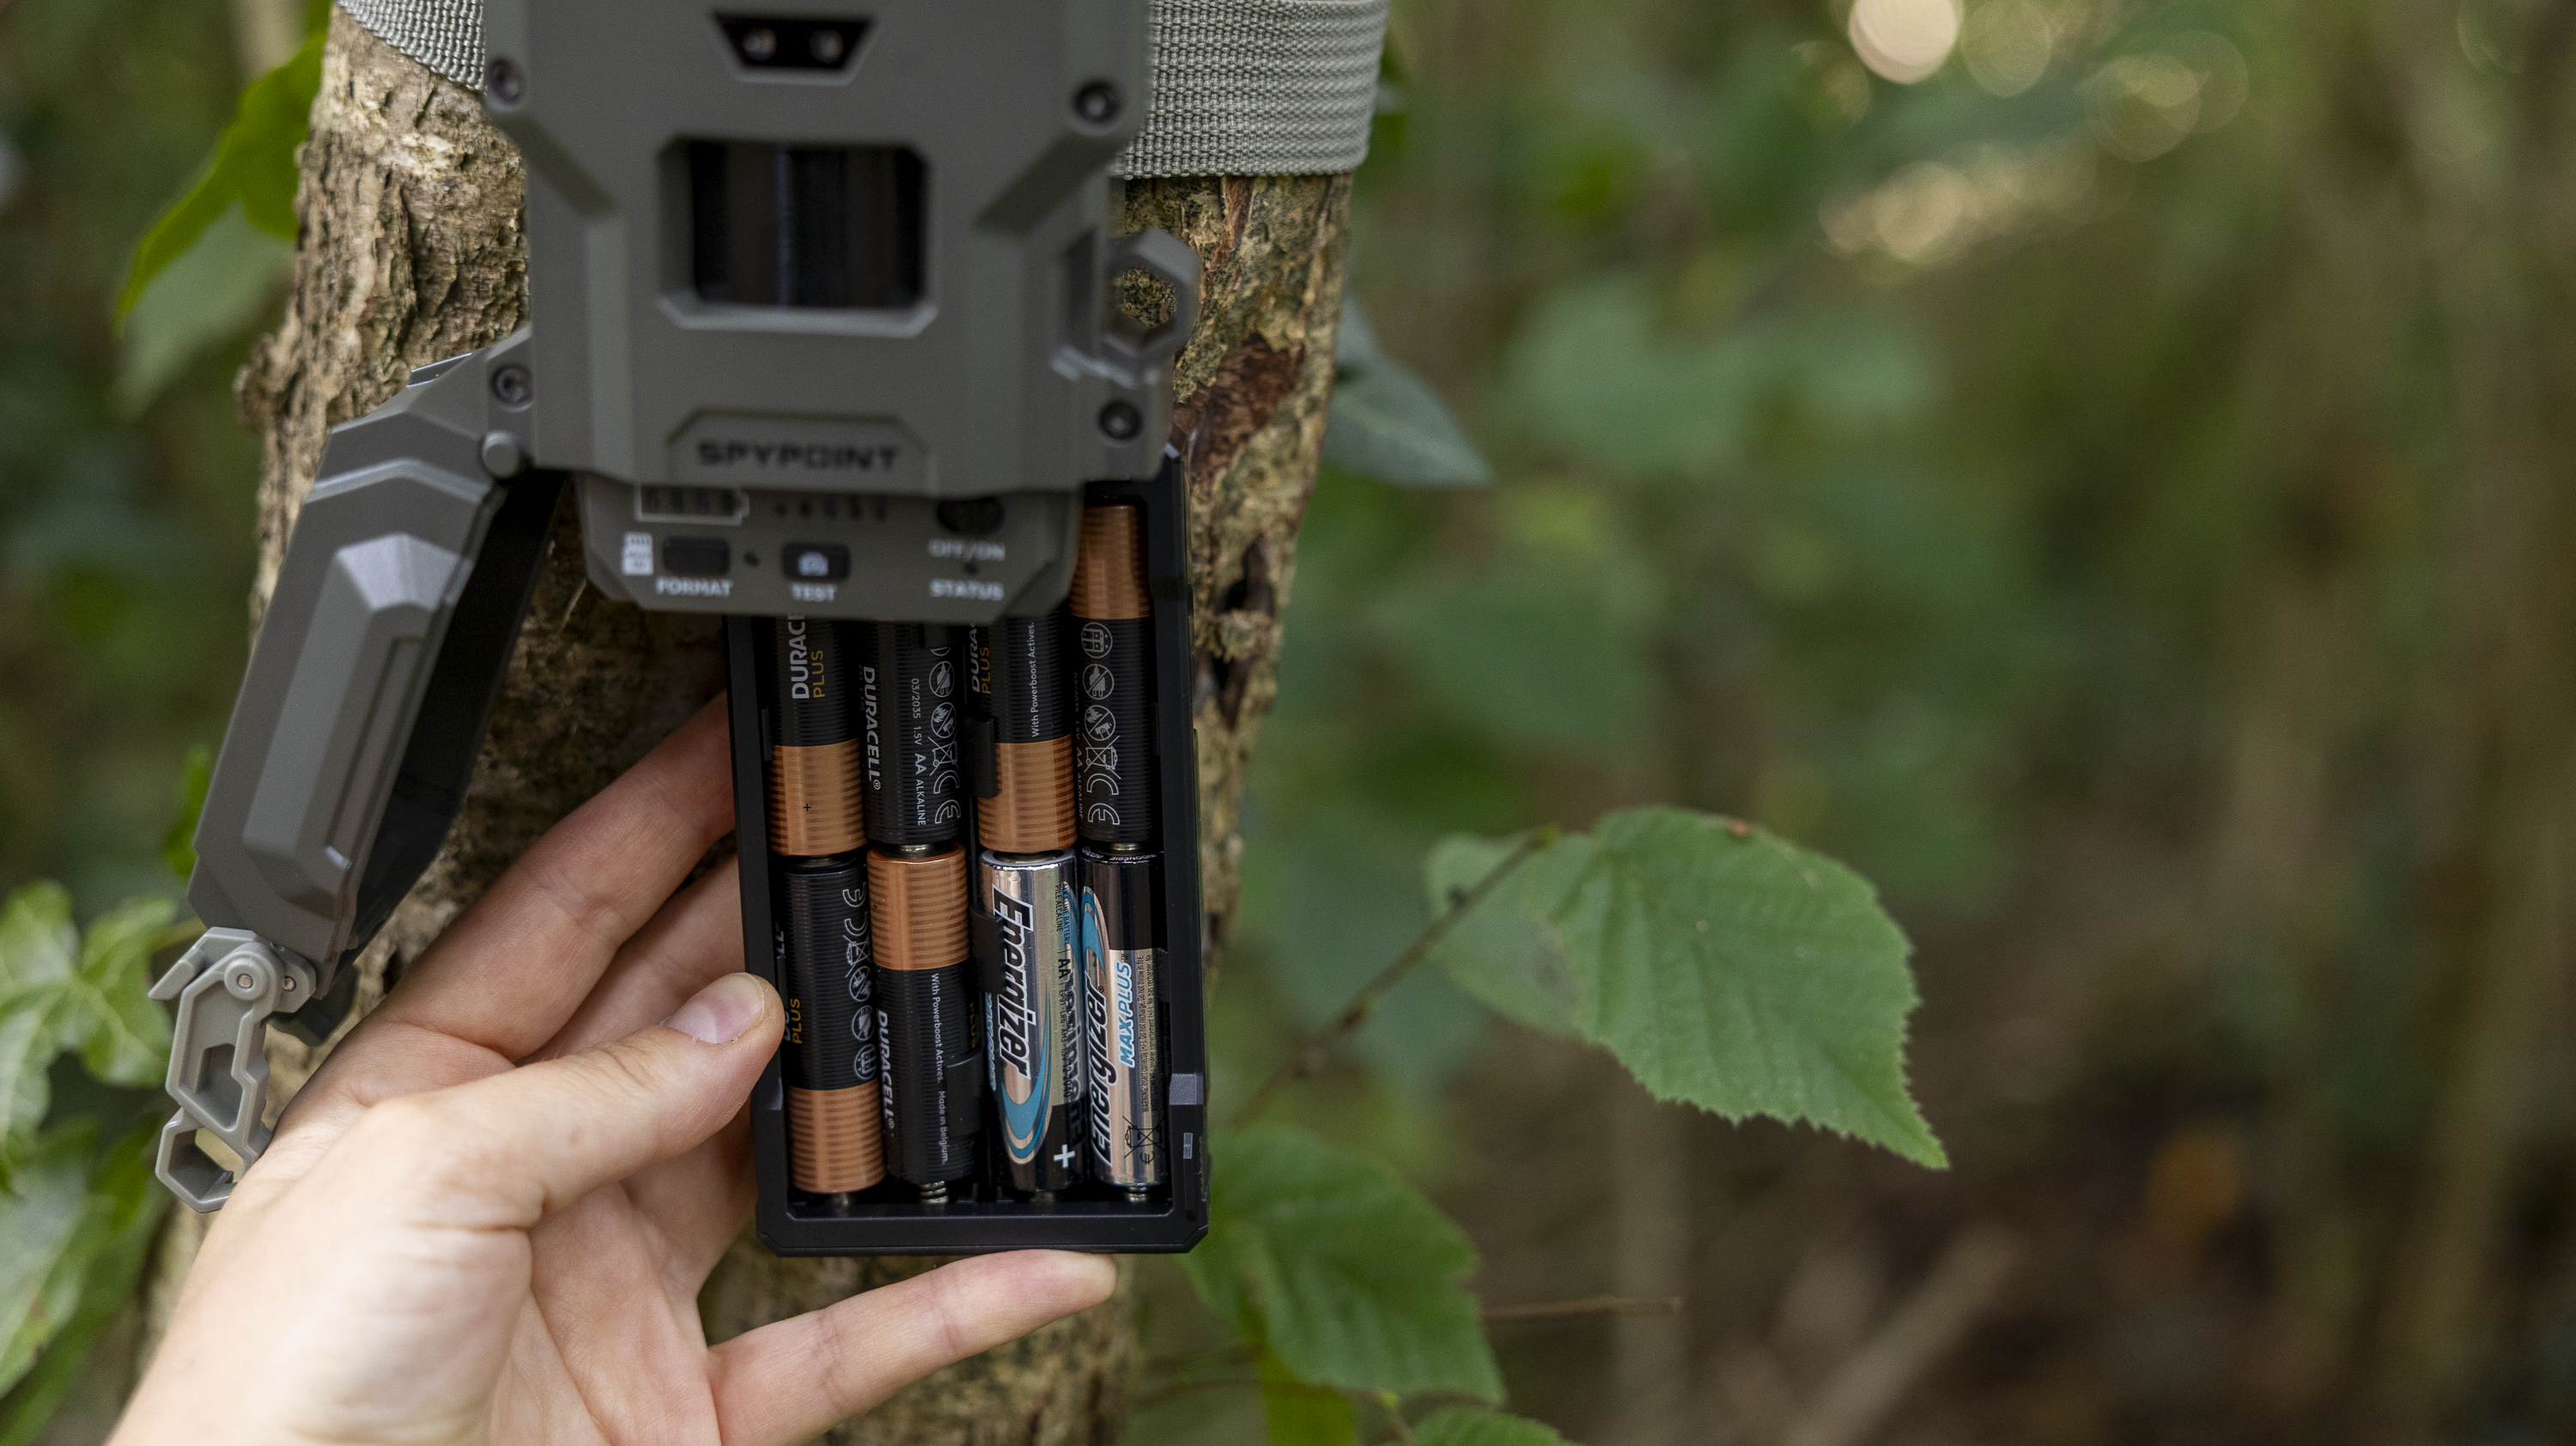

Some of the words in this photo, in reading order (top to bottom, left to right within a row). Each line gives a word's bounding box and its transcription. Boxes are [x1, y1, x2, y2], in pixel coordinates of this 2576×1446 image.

[696, 439, 902, 471] SPYPOINT
[928, 539, 1005, 562] OFF/ON
[655, 578, 733, 598] FORMAT
[791, 583, 836, 602] TEST
[930, 580, 1005, 601] STATUS
[1026, 622, 1036, 658] Actives.
[811, 650, 826, 698] PLUS
[969, 623, 981, 693] DURA
[979, 647, 991, 695] PLUS
[911, 677, 921, 719] 03/2035
[1028, 659, 1039, 713] Powerboost
[913, 726, 922, 745] 1.5V
[1030, 714, 1040, 738] With
[914, 753, 927, 775] AA
[1076, 746, 1084, 768] AA
[915, 779, 927, 826] ALKALINE
[1055, 900, 1064, 933] ALCALINE
[931, 973, 940, 995] With
[1058, 958, 1072, 979] AA
[790, 998, 803, 1044] PLUS
[932, 996, 944, 1048] Powerboost
[1138, 1001, 1146, 1023] recharge.
[1116, 1015, 1135, 1067] MAX
[935, 1048, 945, 1084] Actives.
[1139, 1052, 1148, 1072] correctly
[1062, 1063, 1072, 1097] 12-2040
[938, 1091, 947, 1115] Made
[940, 1116, 948, 1125] in
[939, 1126, 949, 1164] Belgium.
